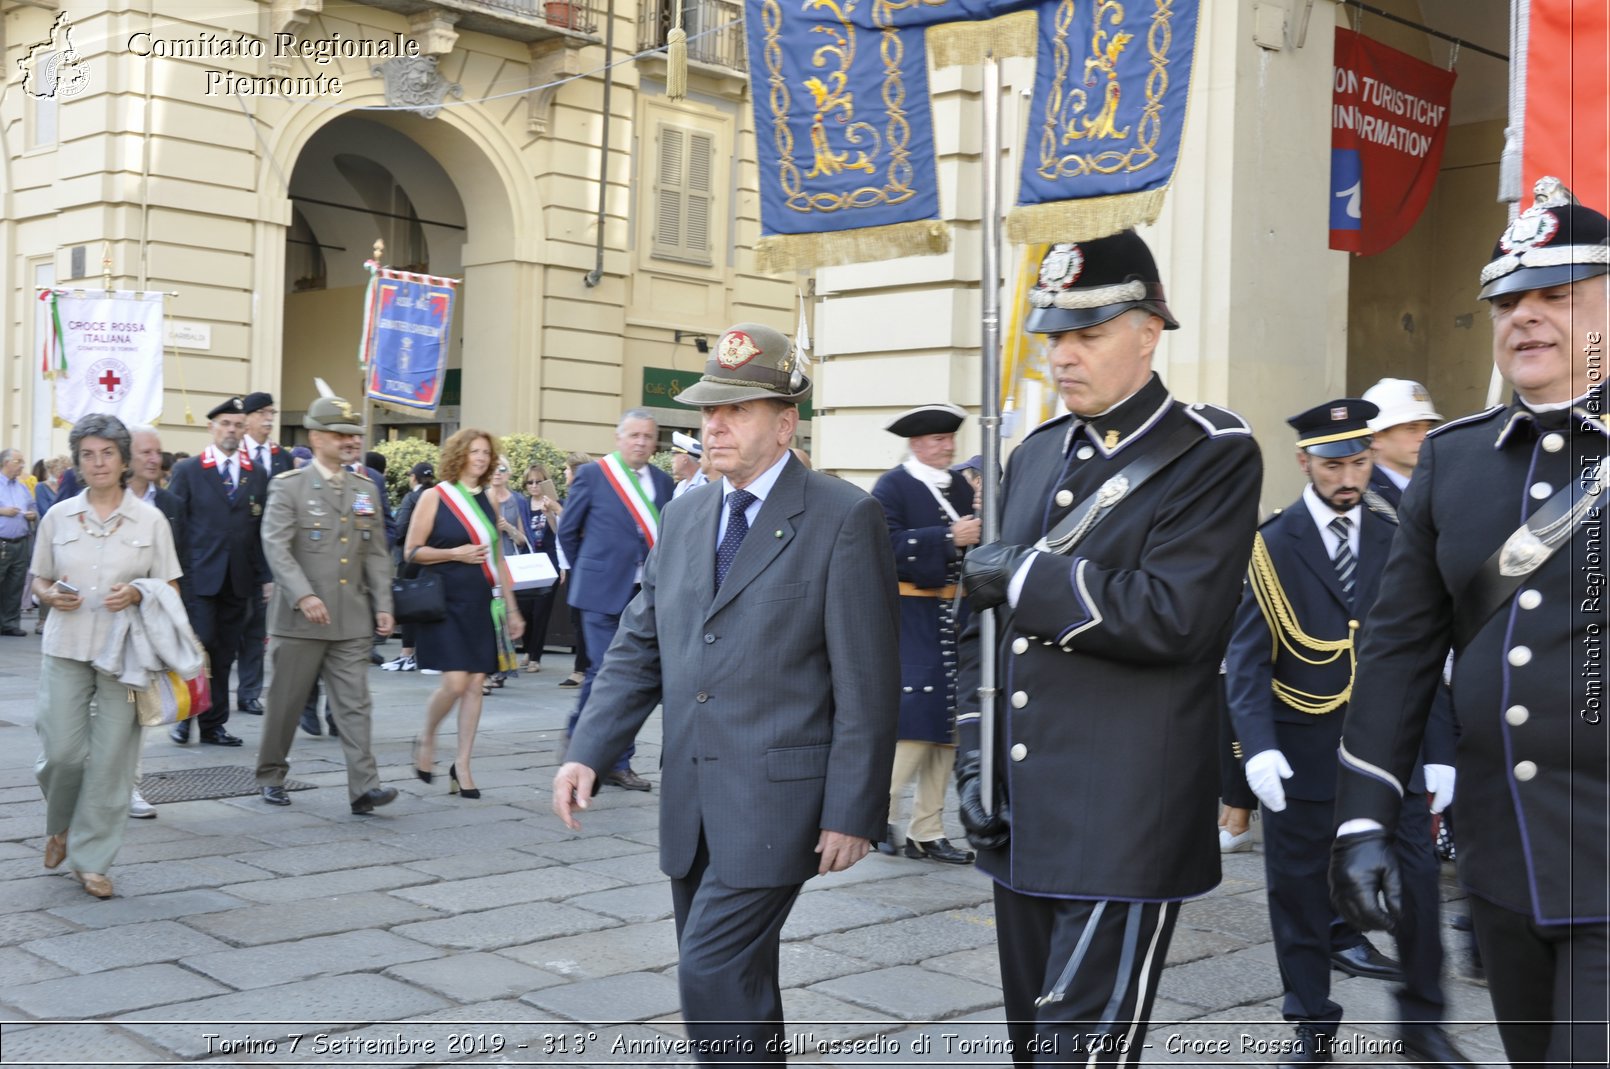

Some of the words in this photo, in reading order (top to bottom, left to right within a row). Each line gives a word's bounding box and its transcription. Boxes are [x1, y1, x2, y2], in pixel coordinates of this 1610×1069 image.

[68, 320, 106, 332] CROCE
[111, 321, 147, 333] ROSSA
[83, 333, 132, 344] ITALIANA
